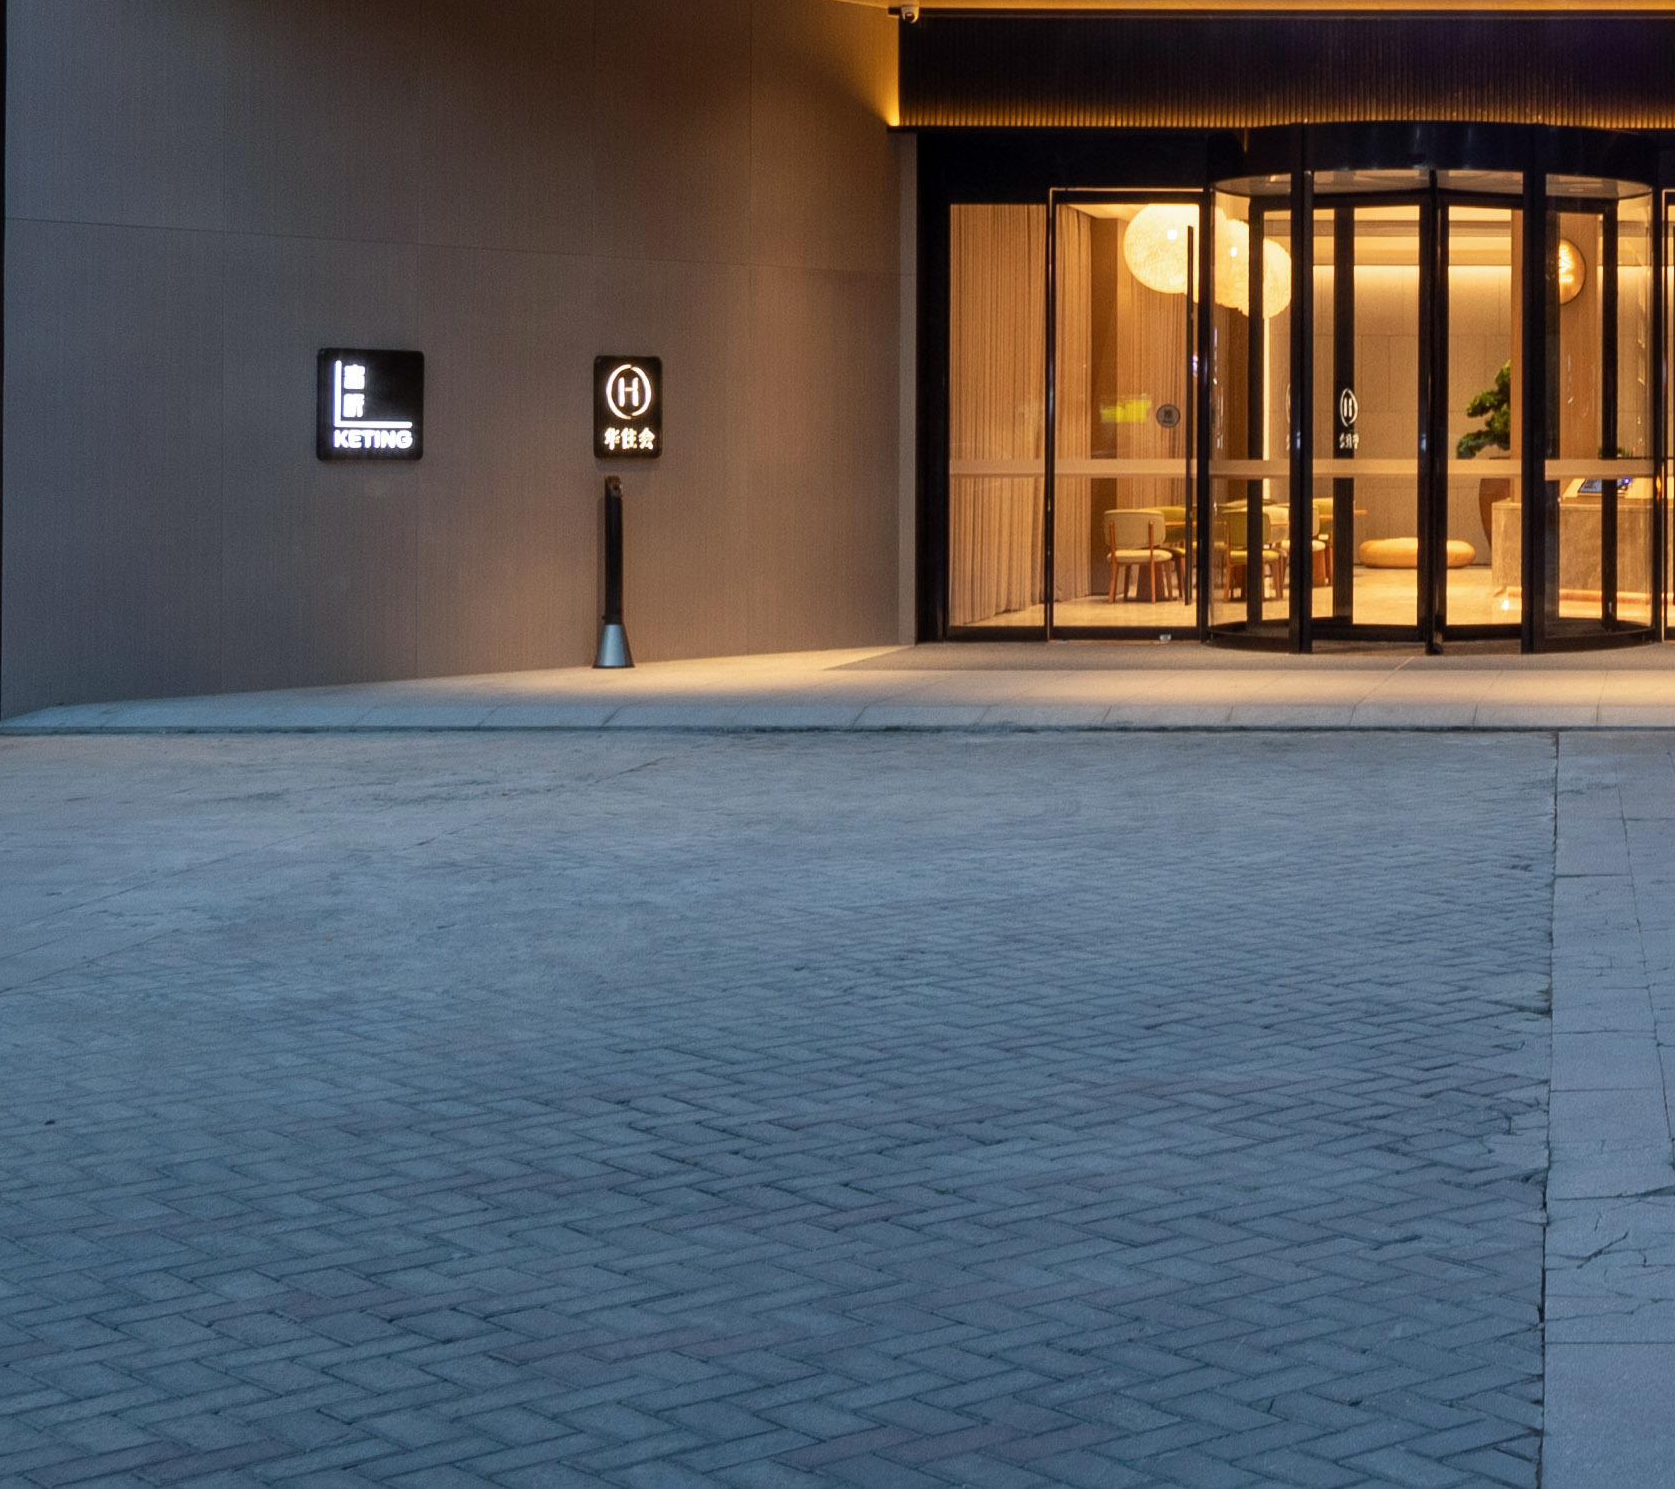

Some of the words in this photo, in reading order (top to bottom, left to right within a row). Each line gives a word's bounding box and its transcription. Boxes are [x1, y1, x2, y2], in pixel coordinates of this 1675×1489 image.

[334, 428, 413, 449] KETING
[604, 427, 655, 450] 华住会
